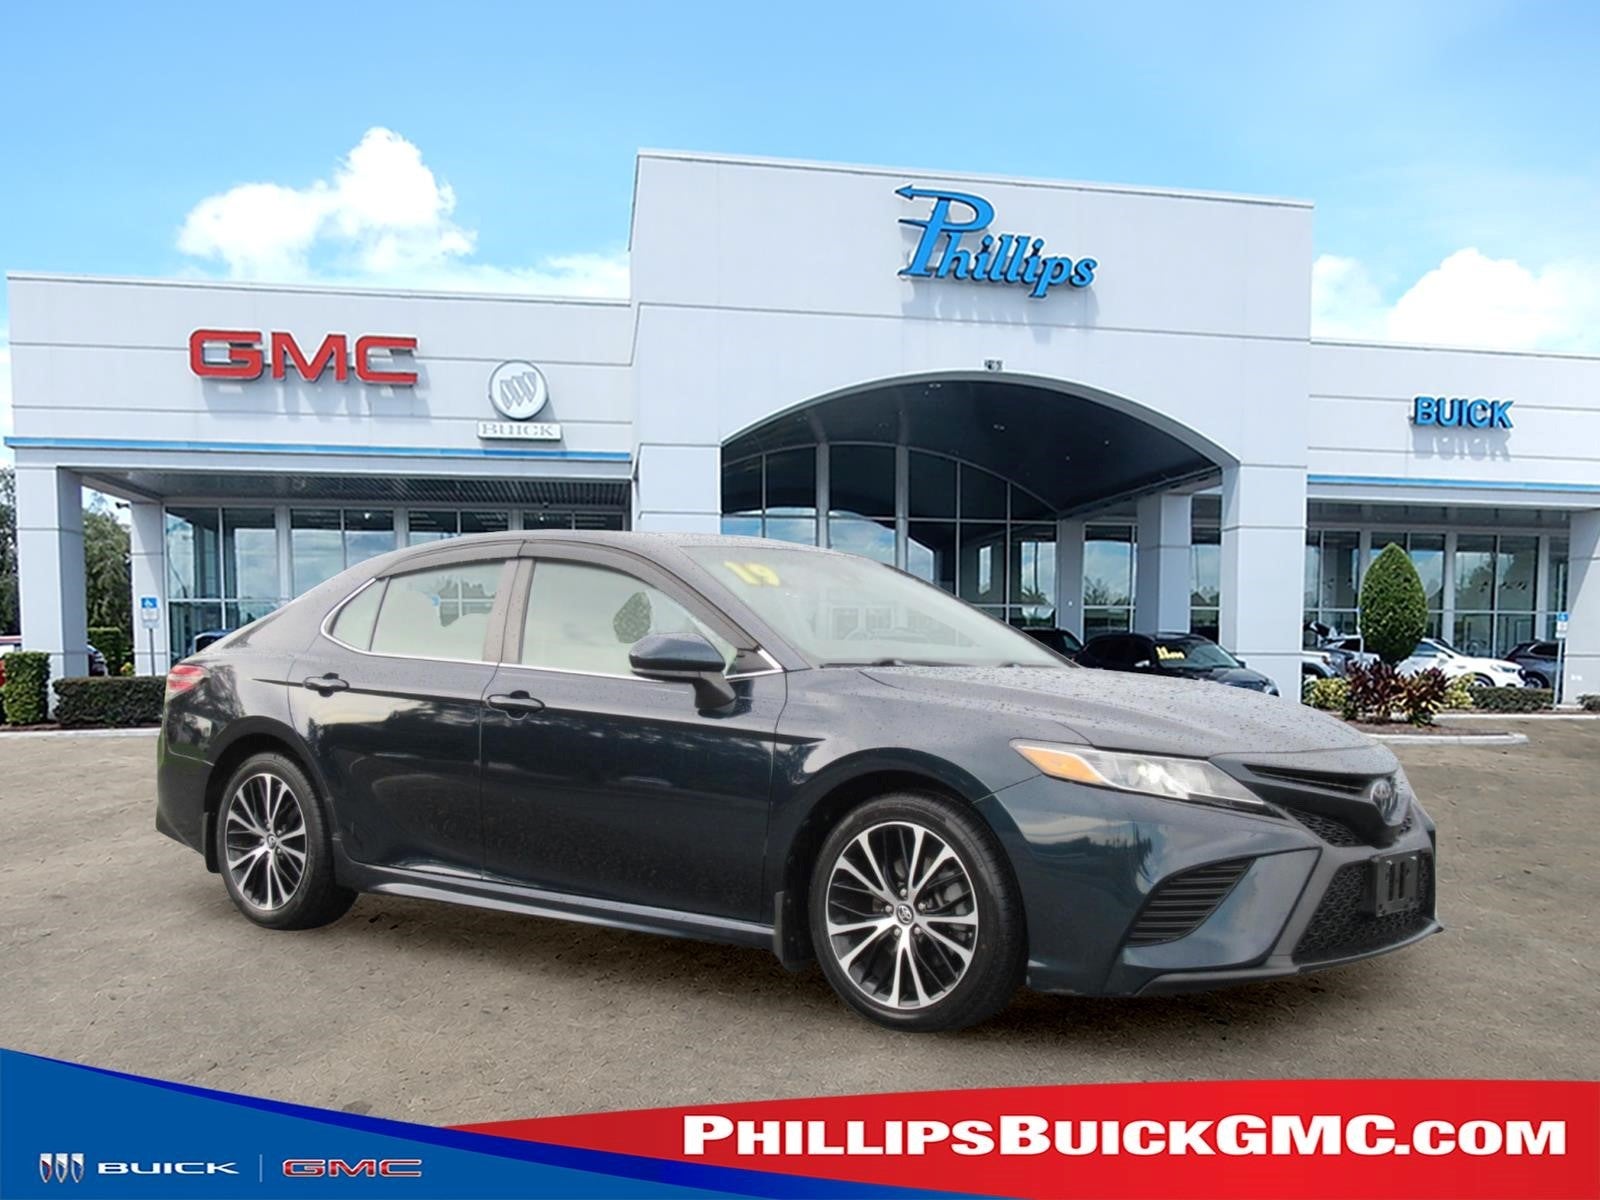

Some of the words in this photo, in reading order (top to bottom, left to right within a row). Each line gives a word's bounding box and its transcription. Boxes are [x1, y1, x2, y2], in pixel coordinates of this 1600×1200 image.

[895, 185, 1098, 298] Phillips
[189, 328, 418, 386] GMC
[482, 423, 553, 436] BUICK
[1413, 396, 1514, 428] BUICK
